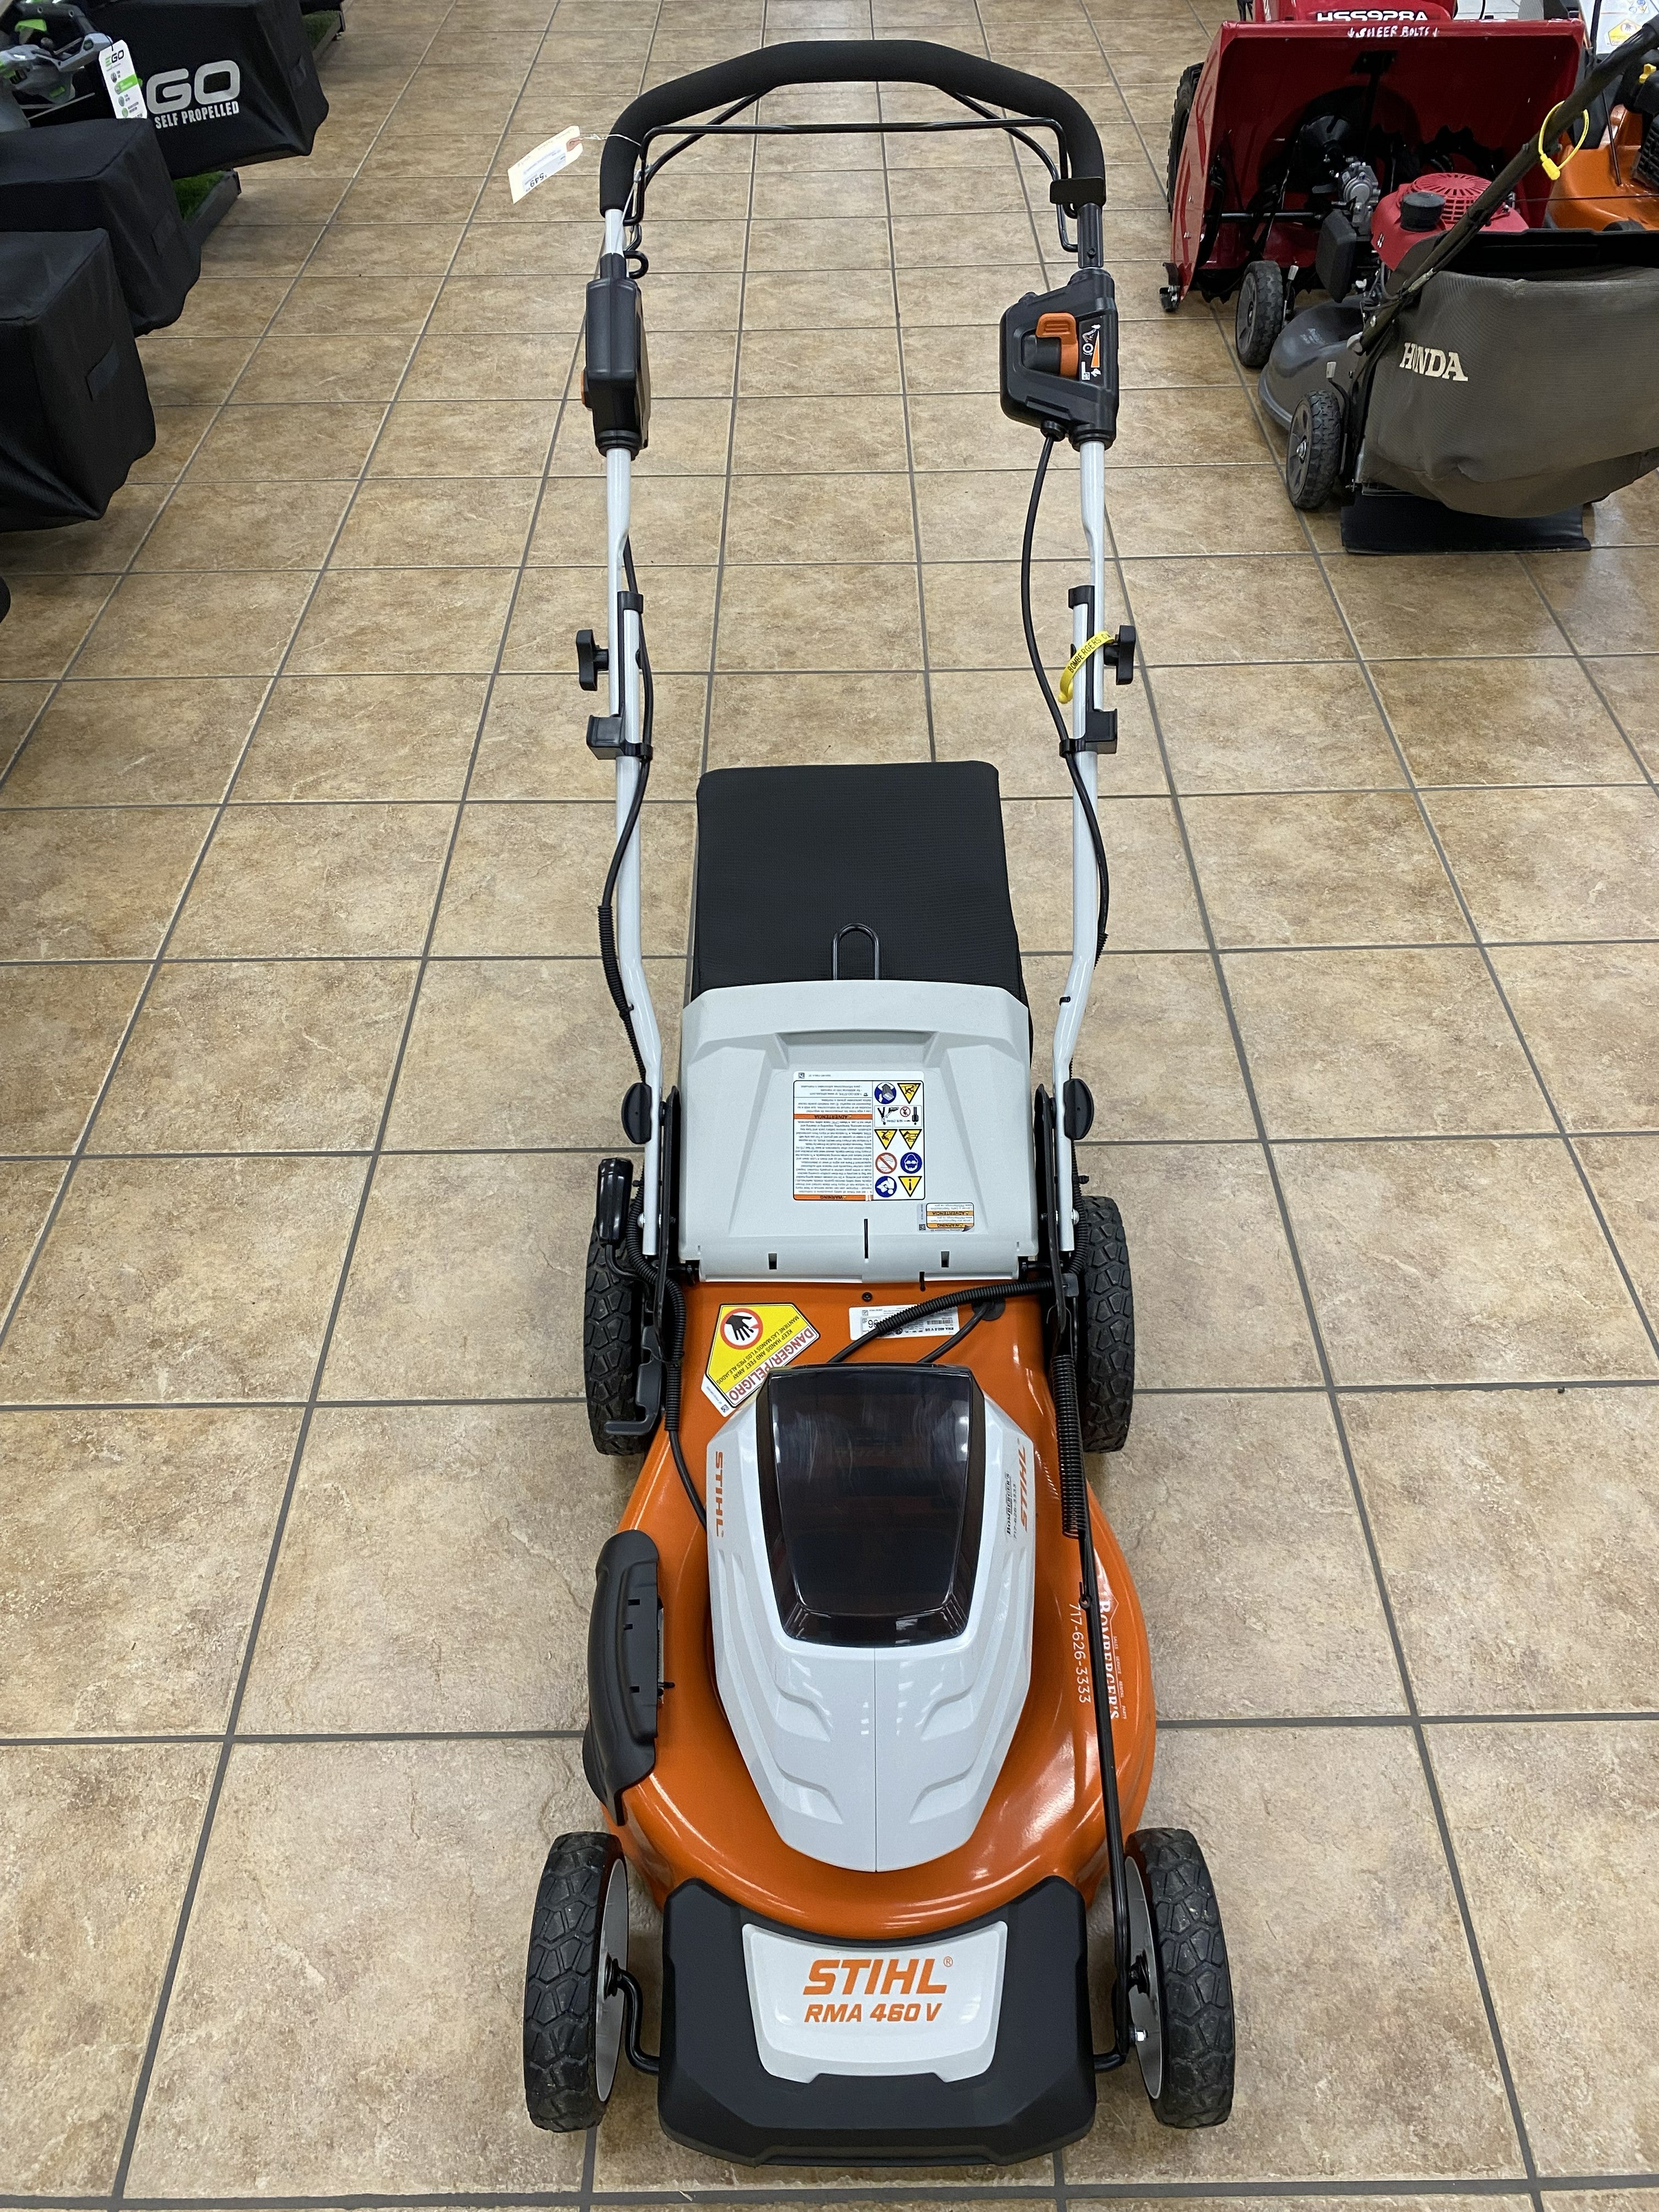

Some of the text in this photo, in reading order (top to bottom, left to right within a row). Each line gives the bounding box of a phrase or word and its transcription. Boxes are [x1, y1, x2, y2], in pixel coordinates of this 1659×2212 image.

[1356, 25, 1398, 38] SHEER
[105, 49, 125, 67] EGO
[146, 60, 240, 114] GO
[154, 101, 240, 129] SELF PROPELLED
[1399, 342, 1469, 381] HONDA
[1067, 636, 1102, 673] BOMBERGERS
[778, 1315, 799, 1334] MANTIENE
[755, 1337, 772, 1352] MANOS
[769, 1331, 780, 1341] LAS
[731, 1328, 793, 1380] KEEP HANDS AND FEET AWAY
[736, 1358, 747, 1368] PIES
[744, 1351, 755, 1361] LOS
[729, 1328, 814, 1401] DANGER/PELIGRO
[715, 1365, 737, 1385] ALEJADOS
[1018, 1444, 1027, 1532] STIHL
[1069, 1602, 1091, 1703] 717-626-3333
[804, 2003, 942, 2022] RMA 460 V
